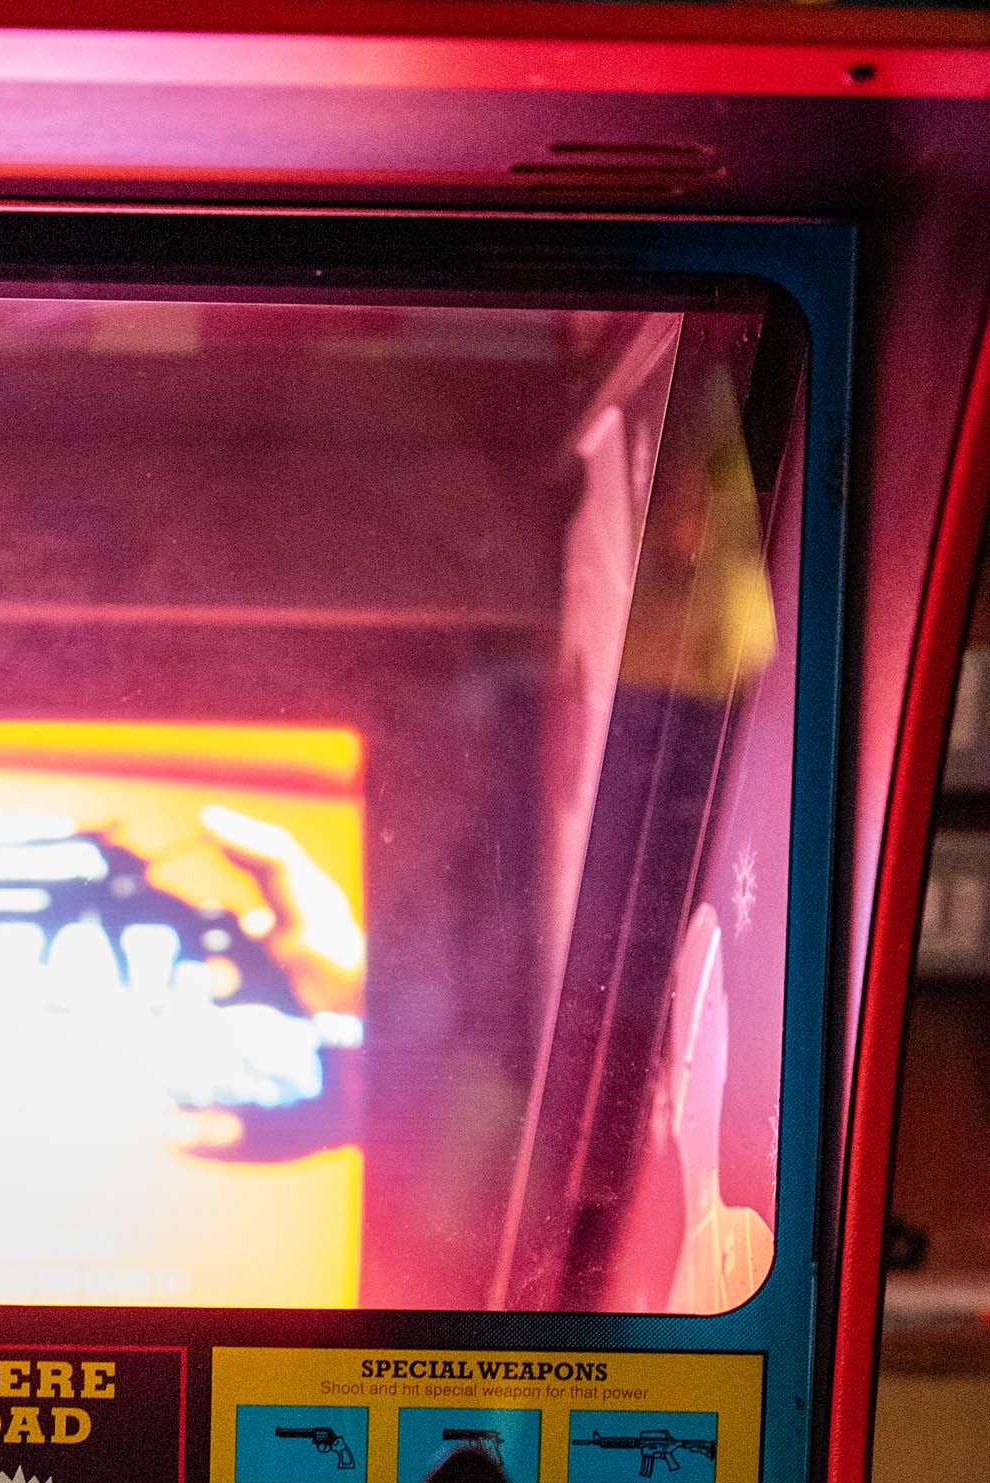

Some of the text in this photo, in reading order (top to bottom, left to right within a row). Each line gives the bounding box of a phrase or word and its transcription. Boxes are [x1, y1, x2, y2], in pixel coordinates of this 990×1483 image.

[361, 1359, 608, 1381] SPECIAL WEAPONS
[320, 1380, 649, 1402] Shoot and hit special weapon for that power
